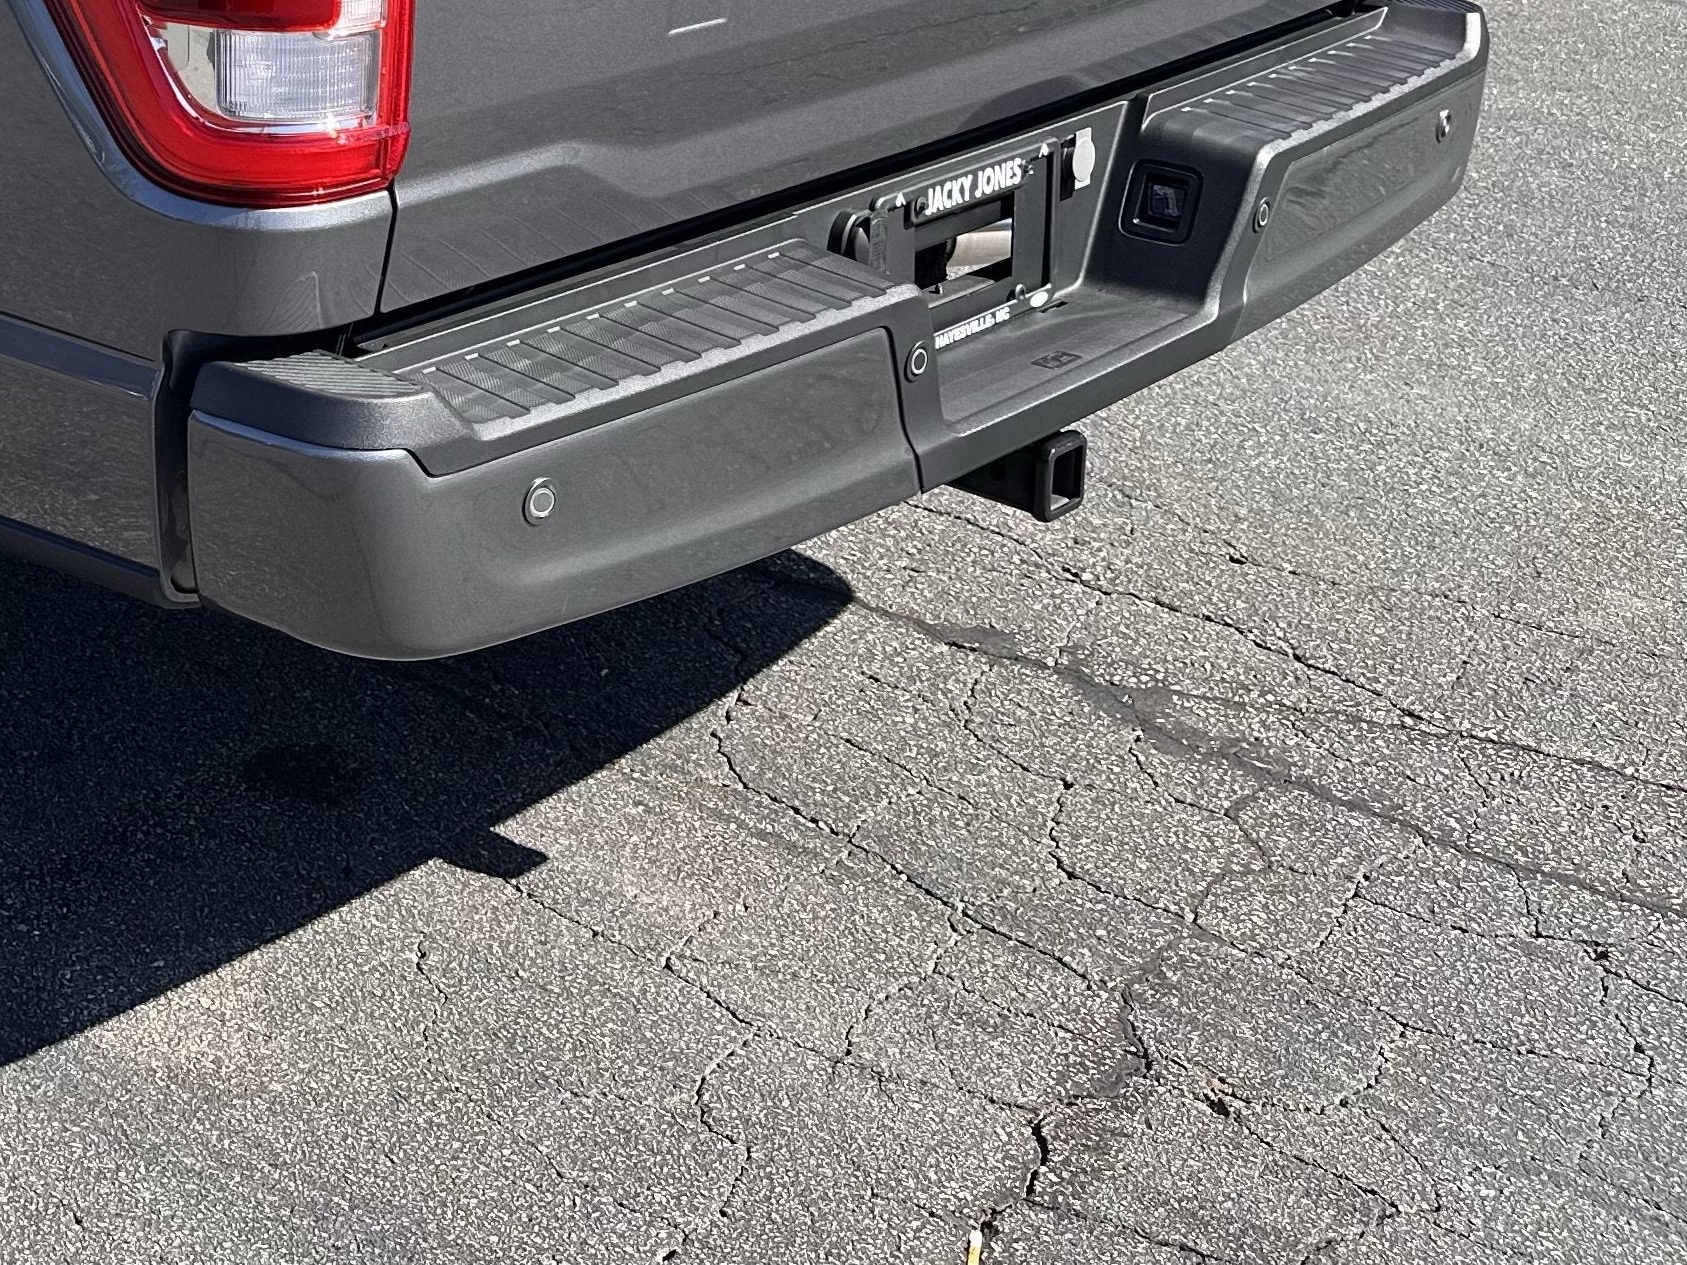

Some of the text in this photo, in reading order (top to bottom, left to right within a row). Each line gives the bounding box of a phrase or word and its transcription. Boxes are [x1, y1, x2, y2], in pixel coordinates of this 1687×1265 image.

[925, 158, 1022, 215] JACKY JONES
[995, 307, 1010, 323] NC
